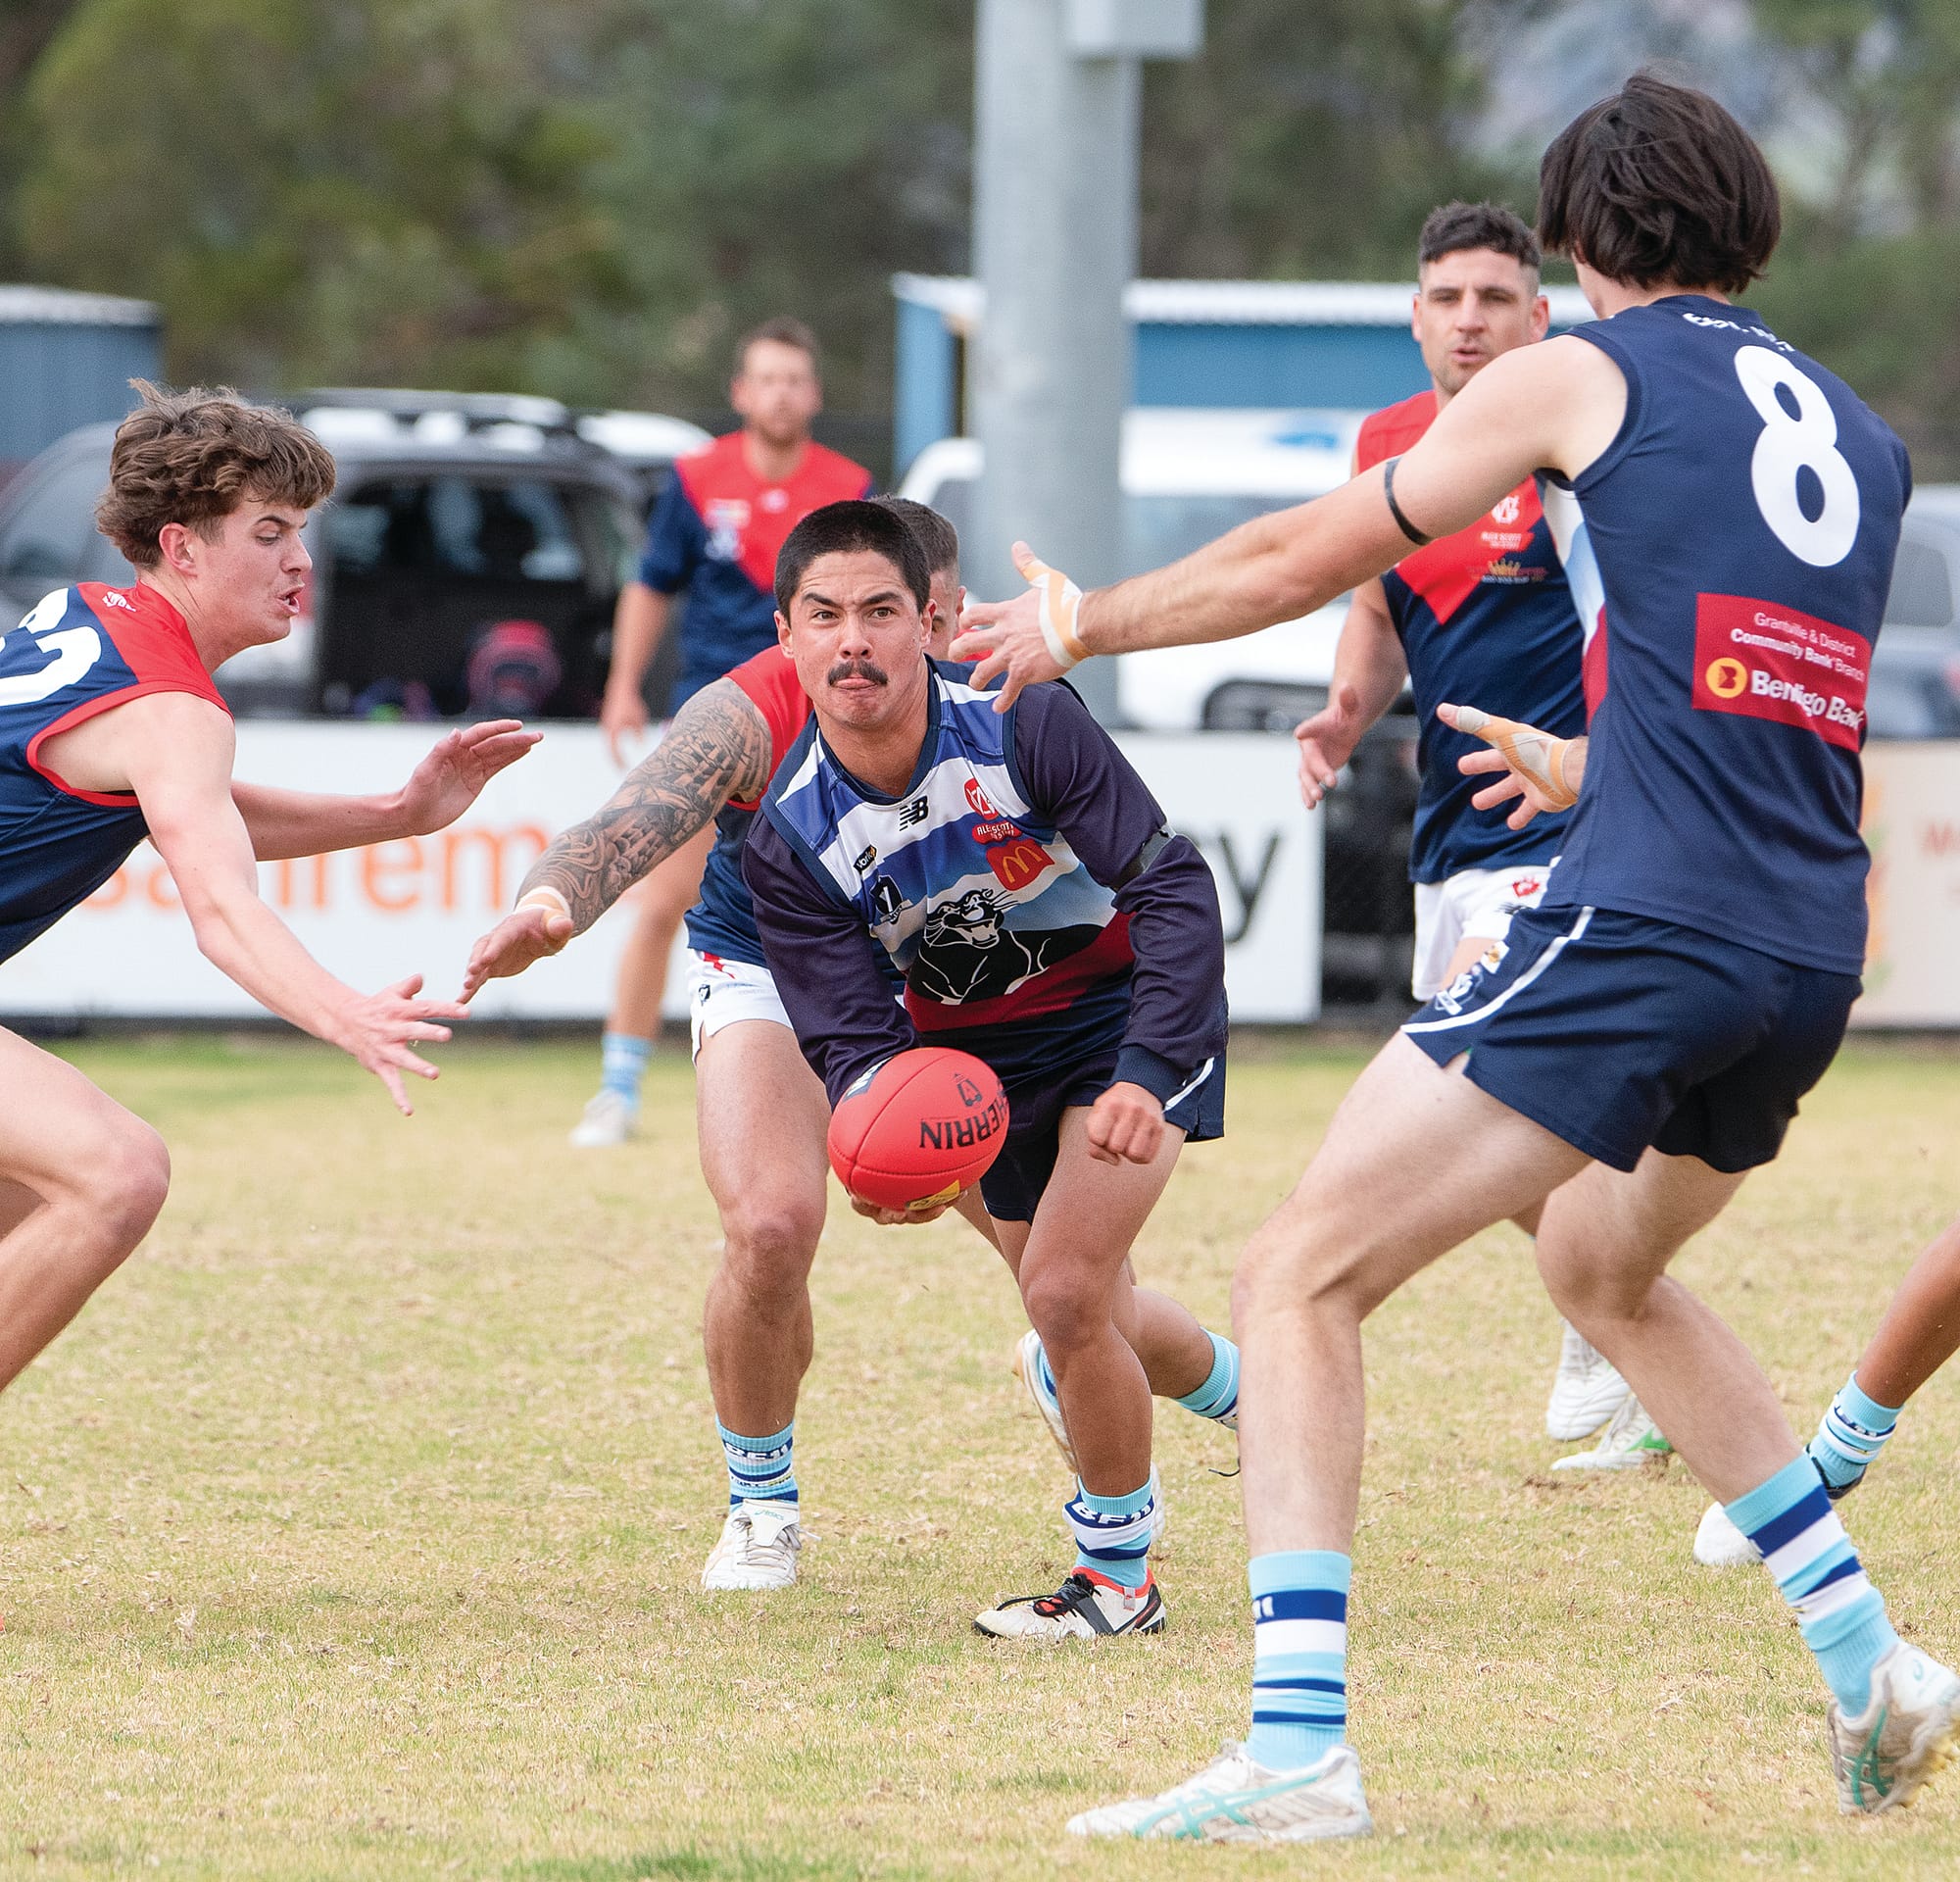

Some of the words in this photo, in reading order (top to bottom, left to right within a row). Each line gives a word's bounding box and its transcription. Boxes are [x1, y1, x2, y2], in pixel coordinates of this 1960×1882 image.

[1734, 345, 1860, 567] 8
[1730, 627, 1804, 660] Community
[1808, 629, 1818, 644] &
[918, 1086, 1009, 1150] HERRIN
